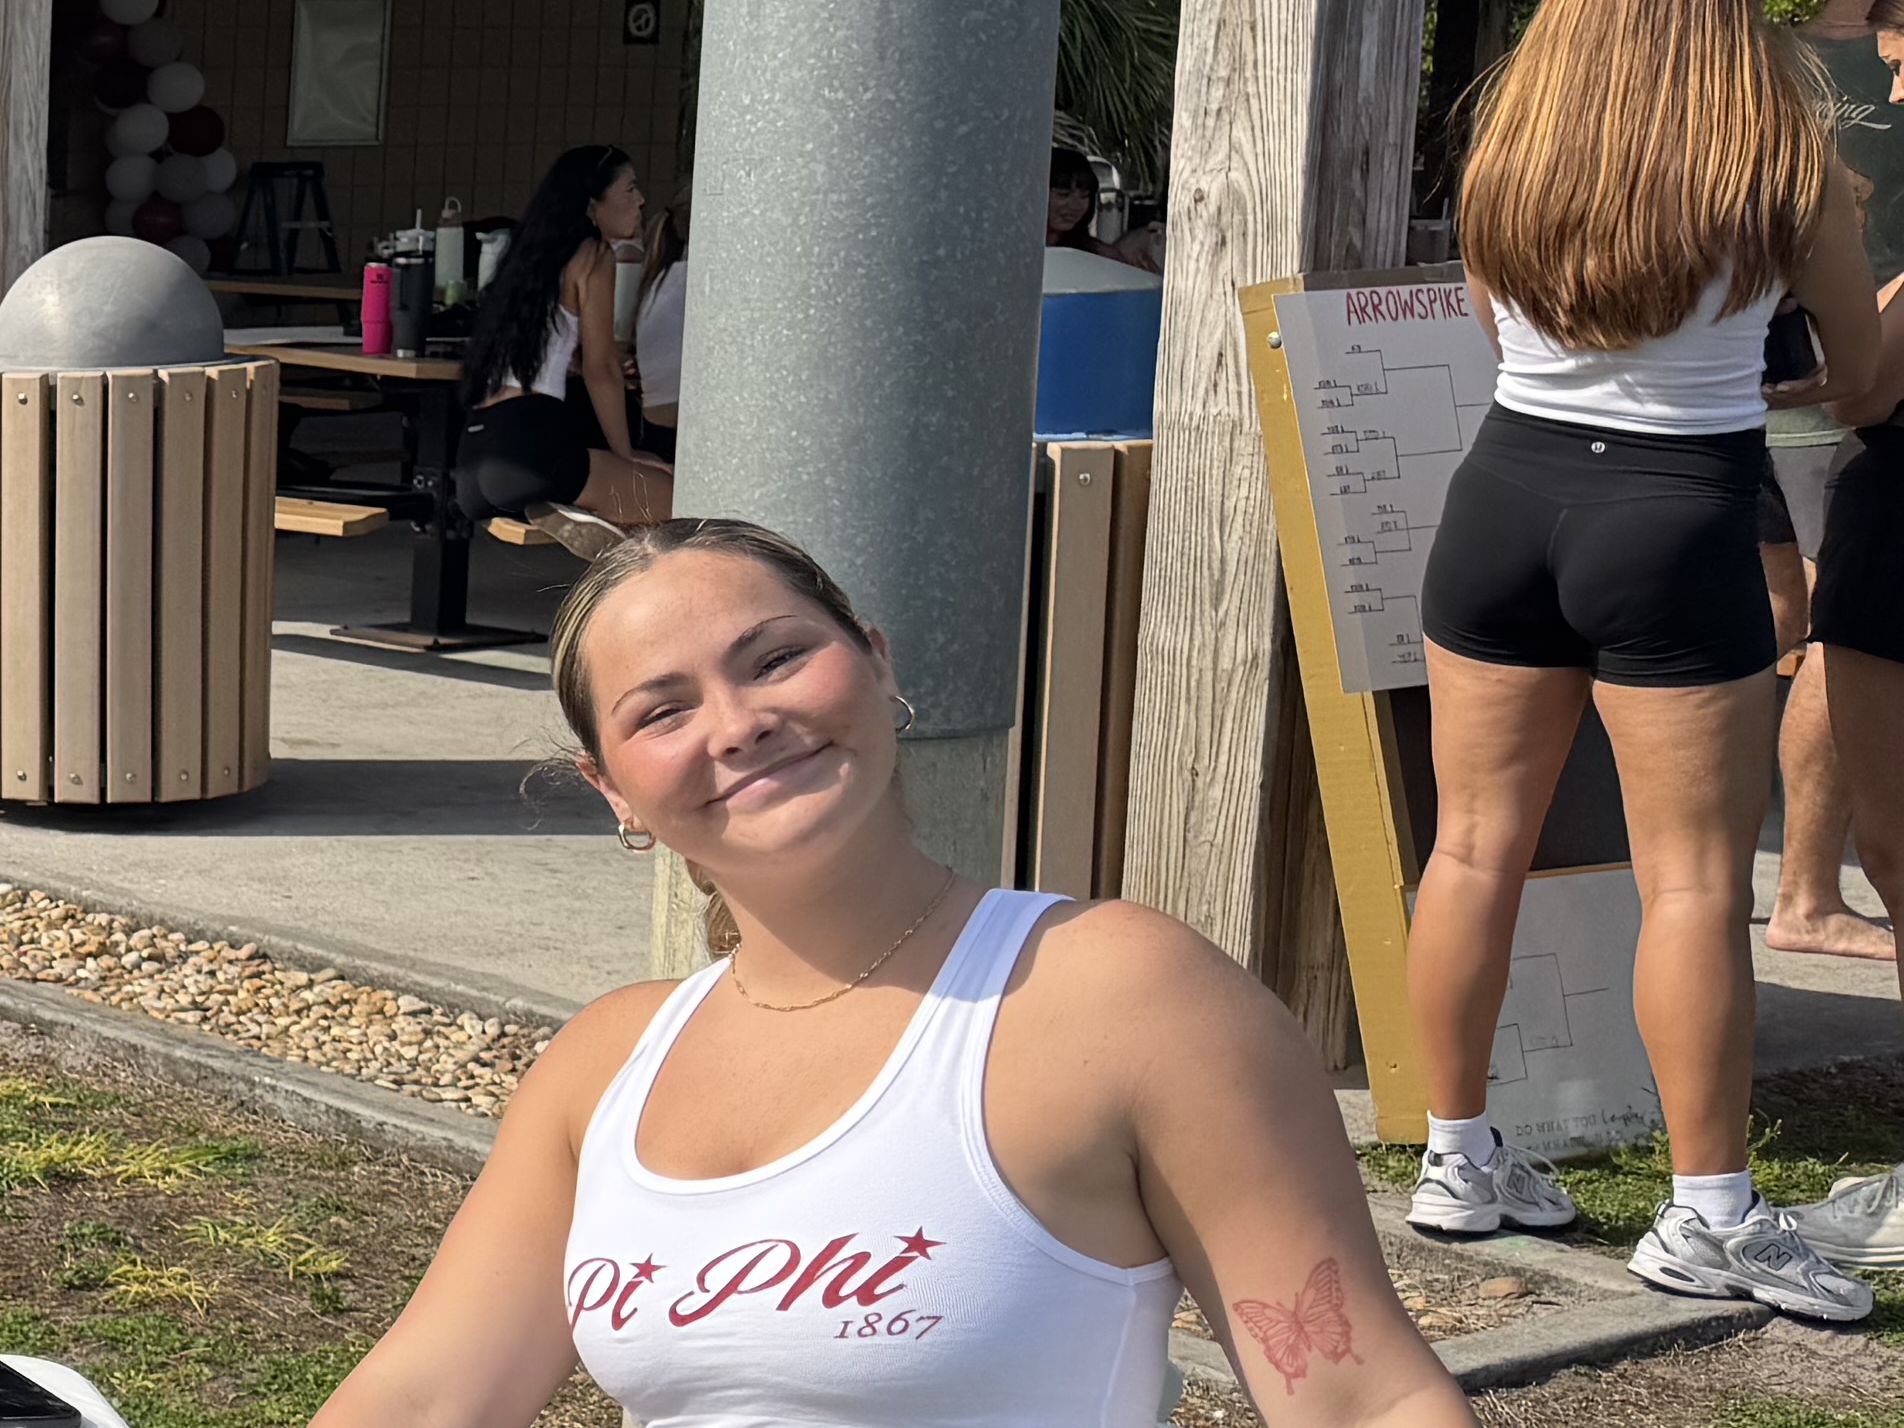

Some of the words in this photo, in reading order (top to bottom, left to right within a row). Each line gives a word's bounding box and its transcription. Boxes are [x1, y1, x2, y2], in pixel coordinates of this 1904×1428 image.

[1345, 286, 1469, 326] ARROWSPIKE
[566, 1252, 668, 1334] Pi
[668, 1225, 946, 1328] Phi
[835, 1310, 945, 1341] 1867
